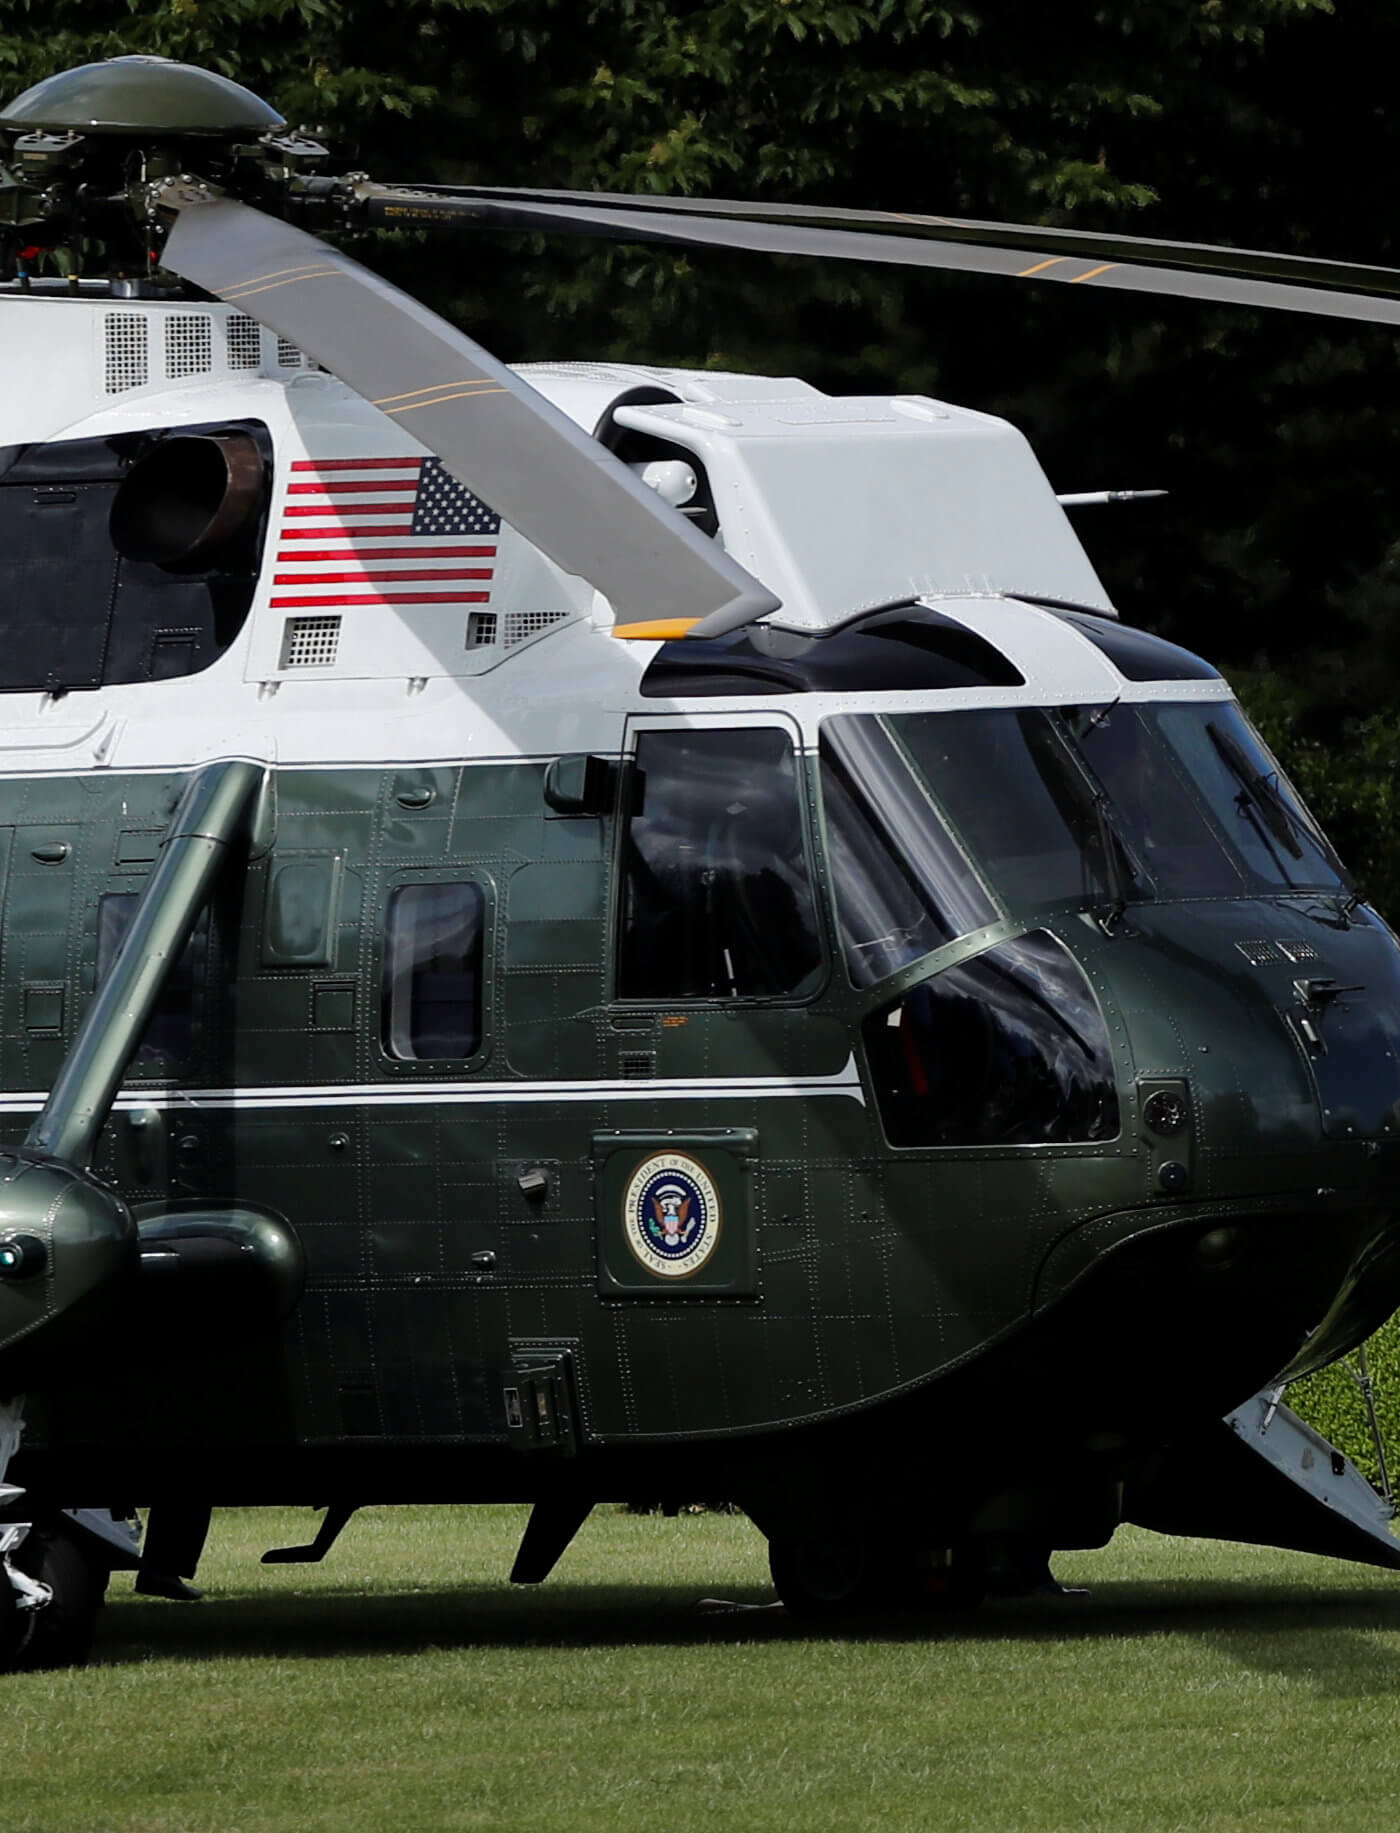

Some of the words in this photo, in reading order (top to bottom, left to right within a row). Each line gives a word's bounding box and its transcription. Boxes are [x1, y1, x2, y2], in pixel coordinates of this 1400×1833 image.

[628, 1158, 665, 1213] PRESIDENT
[695, 1172, 716, 1223] UNITED
[643, 1247, 666, 1270] SEAL
[682, 1232, 713, 1267] STATES
